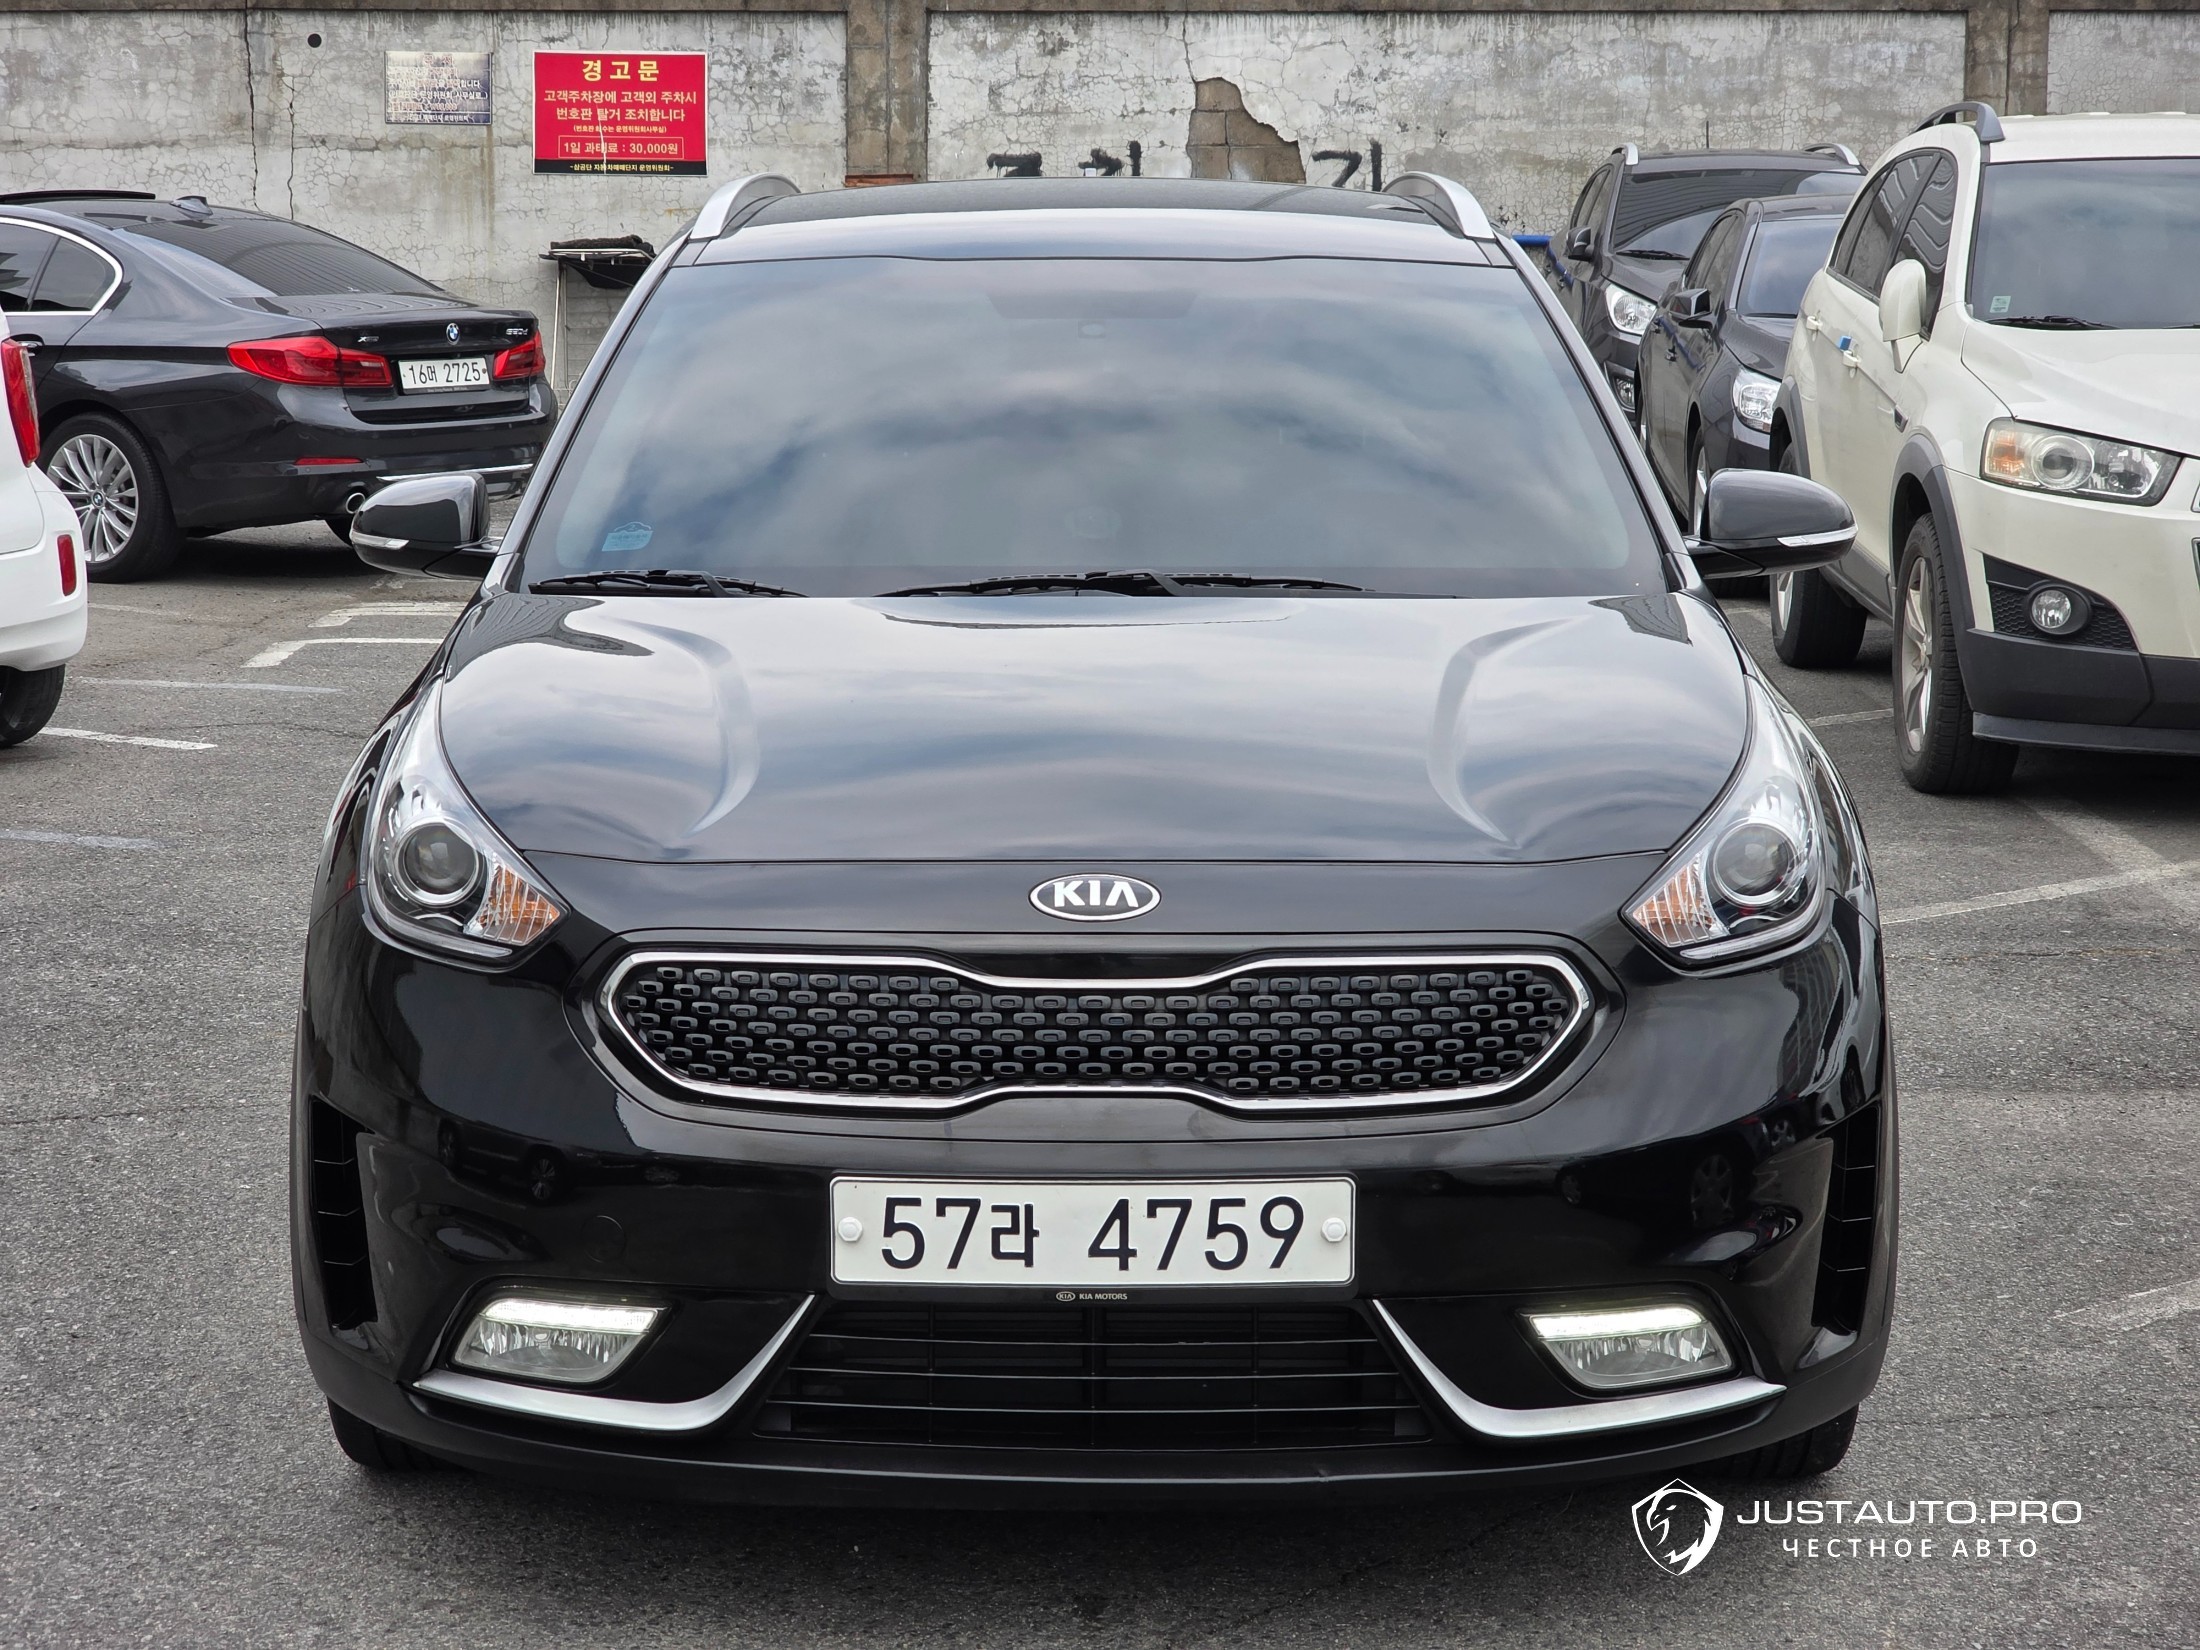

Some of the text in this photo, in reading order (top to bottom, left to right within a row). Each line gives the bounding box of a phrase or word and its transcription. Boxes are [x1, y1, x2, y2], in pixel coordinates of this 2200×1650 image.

[582, 59, 660, 81] 경고문
[544, 90, 697, 104] 고객주차장에 고객외 주차시
[556, 108, 685, 122] 번호판 탈거 조치합니다
[564, 142, 580, 153] 1일
[584, 142, 618, 154] 과태료
[629, 142, 678, 155] 30,000원
[409, 362, 481, 384] 16머 2725
[1053, 879, 1139, 908] KIA
[881, 1196, 1305, 1271] 57라 4759
